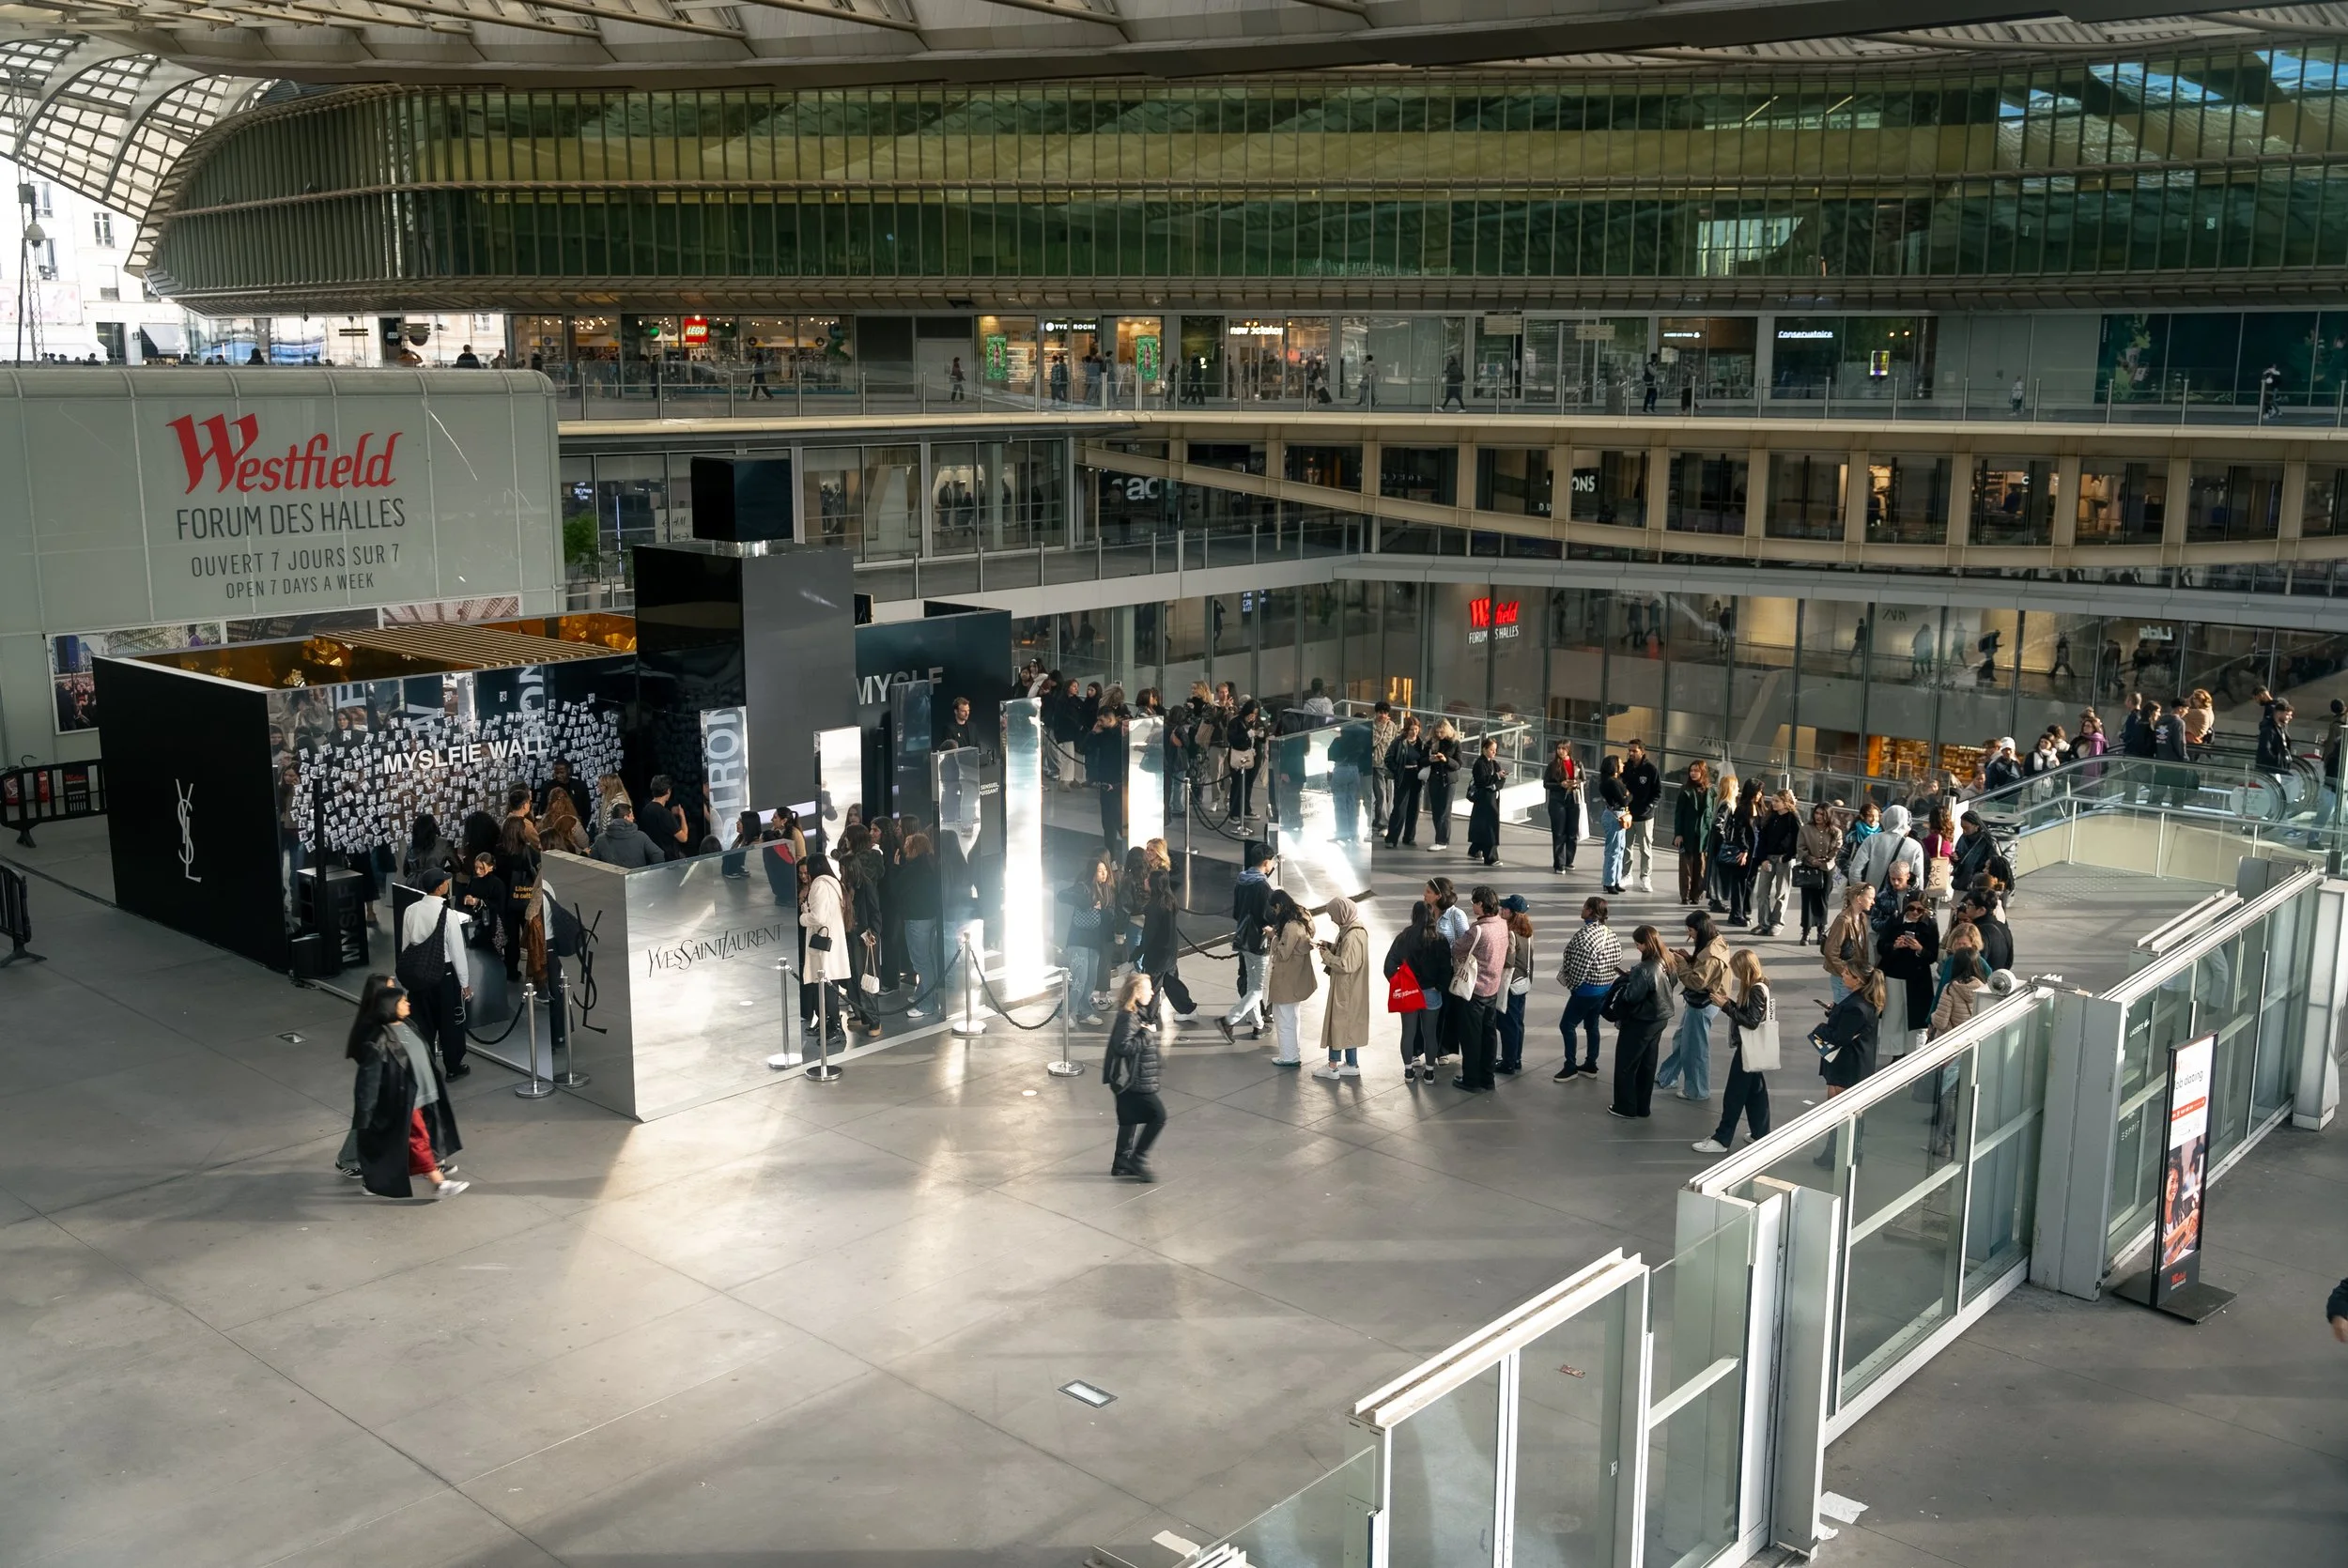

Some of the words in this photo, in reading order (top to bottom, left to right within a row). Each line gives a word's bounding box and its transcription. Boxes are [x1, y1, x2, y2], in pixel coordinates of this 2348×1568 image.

[687, 325, 706, 336] LEGO
[165, 413, 403, 495] Westfield
[177, 505, 263, 540] FORUM
[270, 503, 314, 534] DES
[320, 498, 406, 531] HALLES
[192, 553, 263, 576] OUVERT
[271, 551, 279, 571] 7
[288, 547, 346, 571] JOURS
[353, 545, 385, 566] SUR
[392, 544, 399, 561] 7
[226, 580, 264, 598] OPEN
[270, 579, 276, 595] 7
[284, 576, 317, 594] DAYS
[324, 576, 332, 591] A
[337, 573, 375, 590] WEEK
[1469, 596, 1521, 628] Wefield
[1468, 630, 1489, 645] FORUM
[1499, 624, 1520, 639] HALLES
[384, 744, 482, 775] MYSLFIE
[488, 735, 549, 760] WALL
[338, 885, 360, 963] MYSLF
[2128, 1022, 2144, 1038] LACOSTE
[2121, 1120, 2140, 1142] ESPRIT
